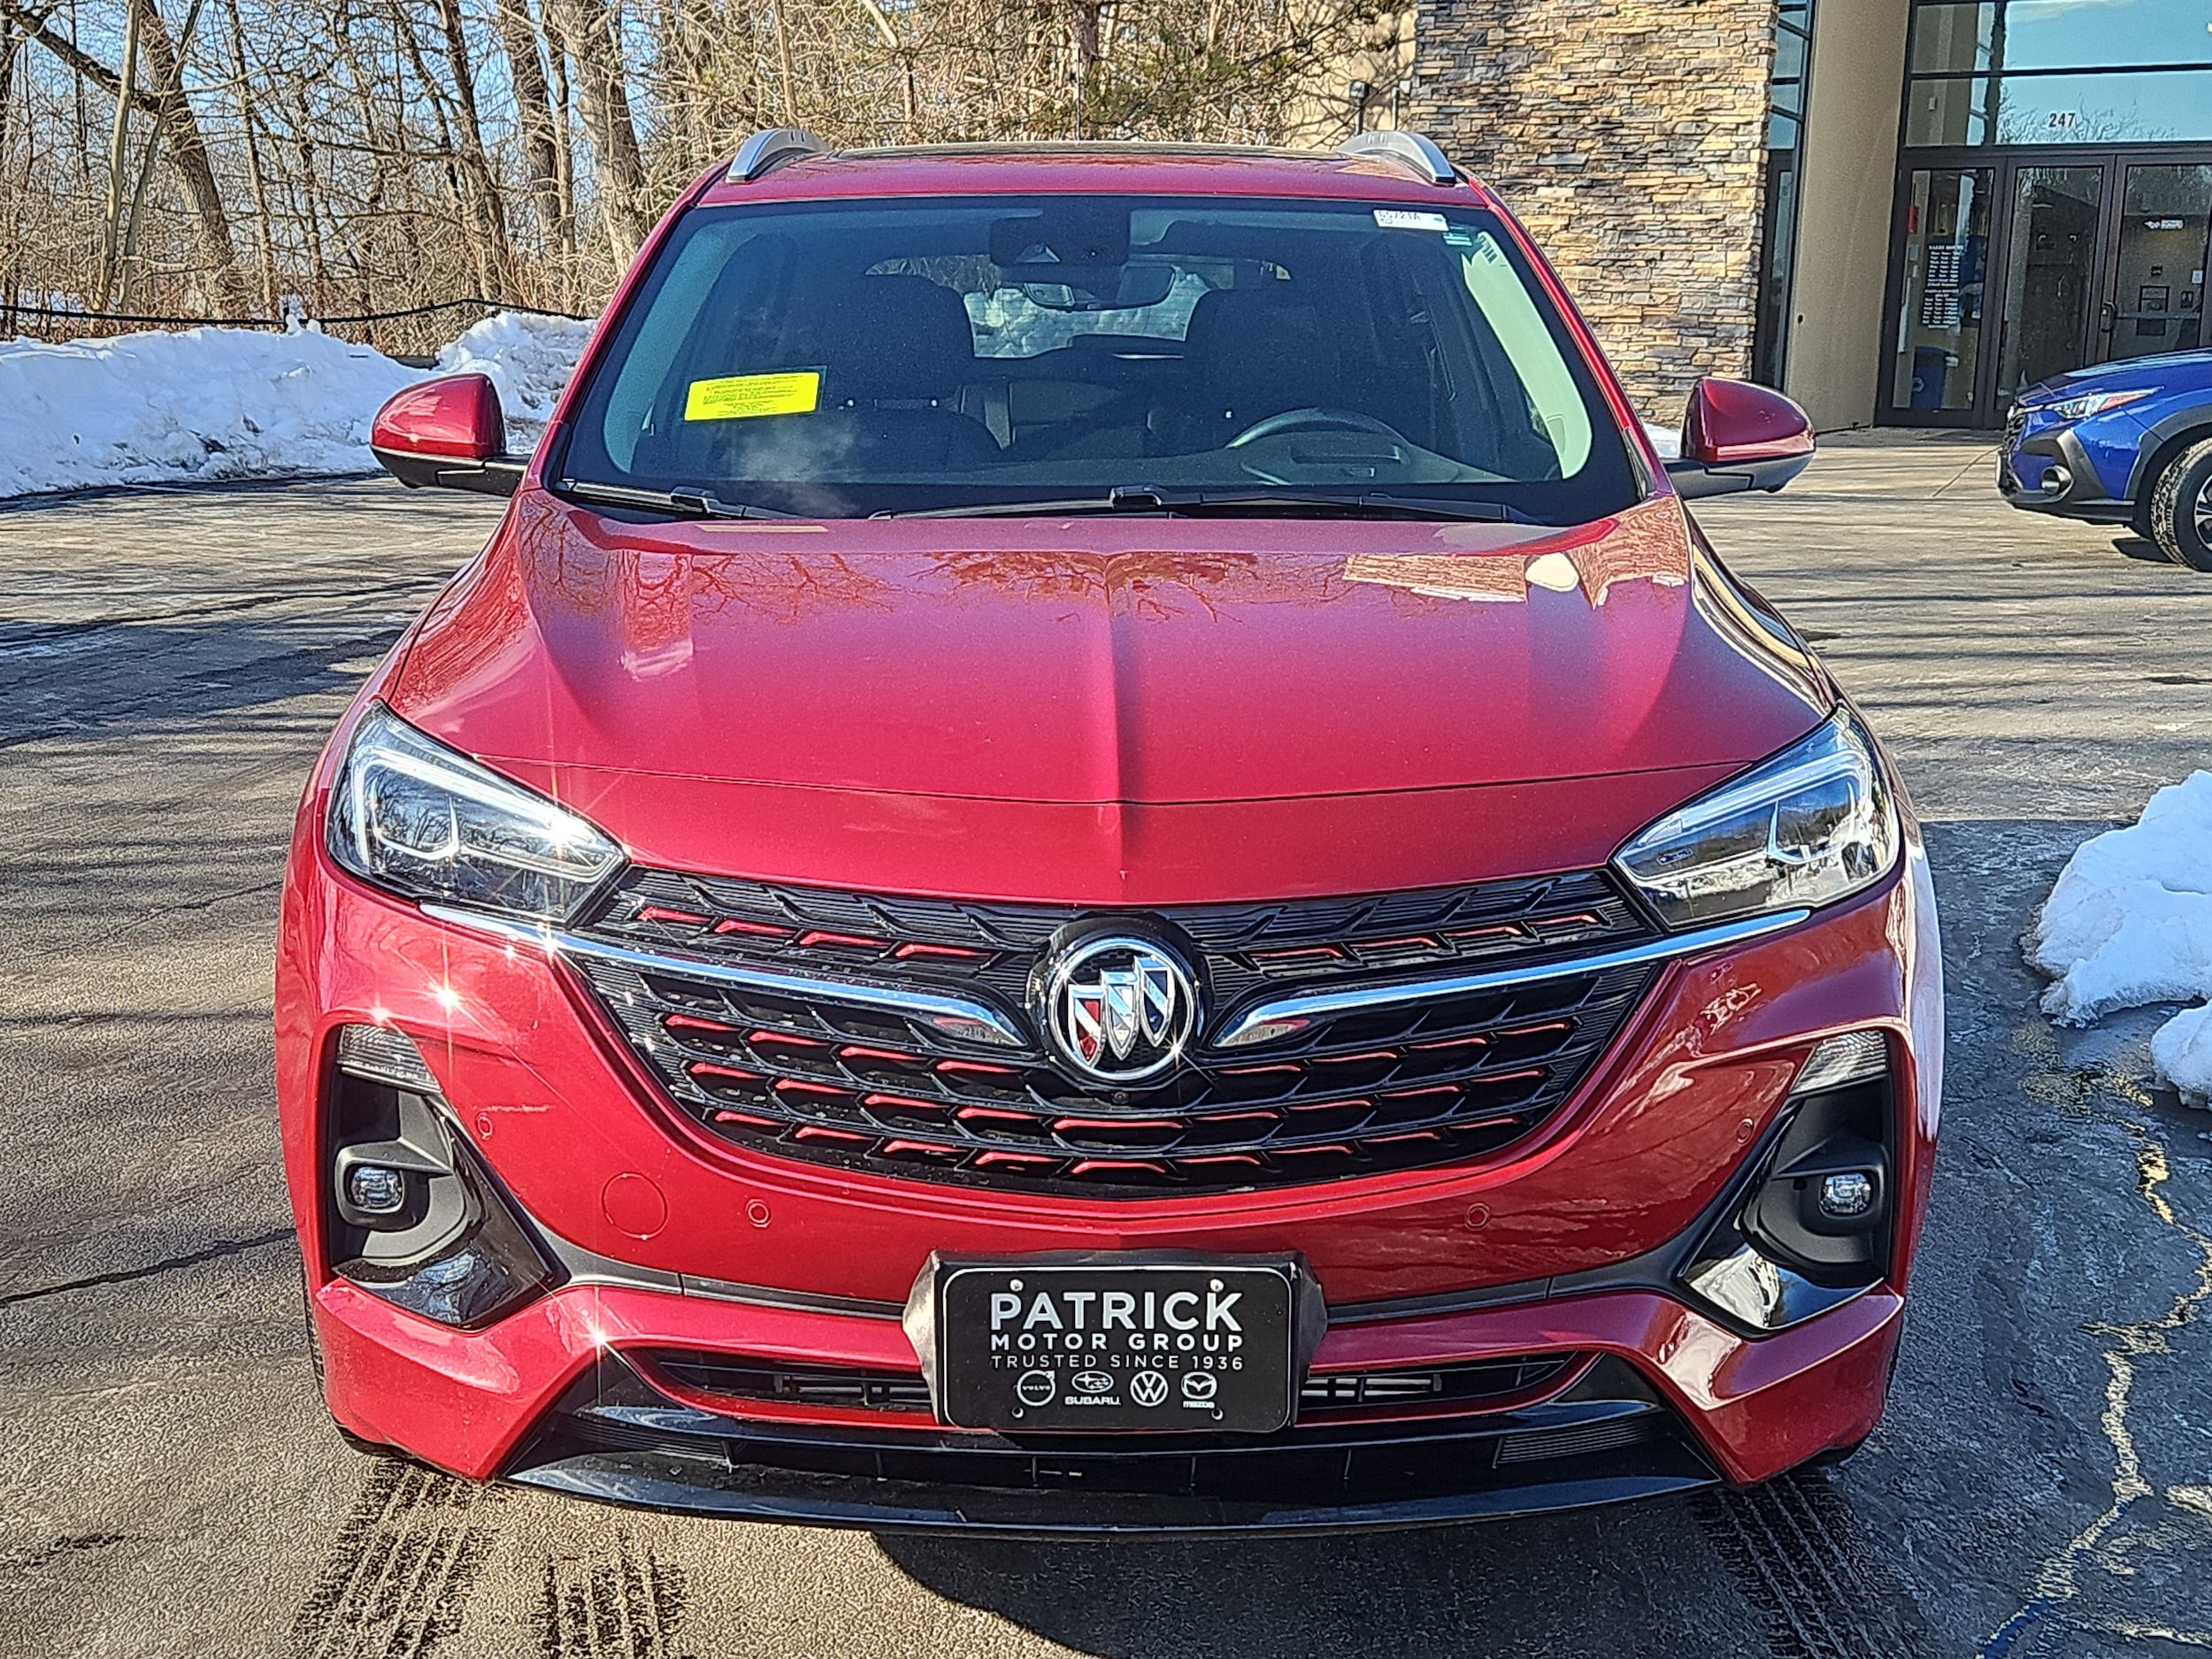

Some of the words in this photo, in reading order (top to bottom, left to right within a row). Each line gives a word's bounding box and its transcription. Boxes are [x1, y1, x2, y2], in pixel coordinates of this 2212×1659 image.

[2048, 112, 2076, 127] 247
[990, 1291, 1243, 1332] PATRICK
[990, 1333, 1108, 1352] MOTOR
[1128, 1333, 1243, 1353] GROUP
[990, 1354, 1097, 1369] TRUSTED
[1110, 1354, 1179, 1369] SINCE
[1192, 1355, 1243, 1371] 1936
[1064, 1395, 1121, 1406] SUBARU
